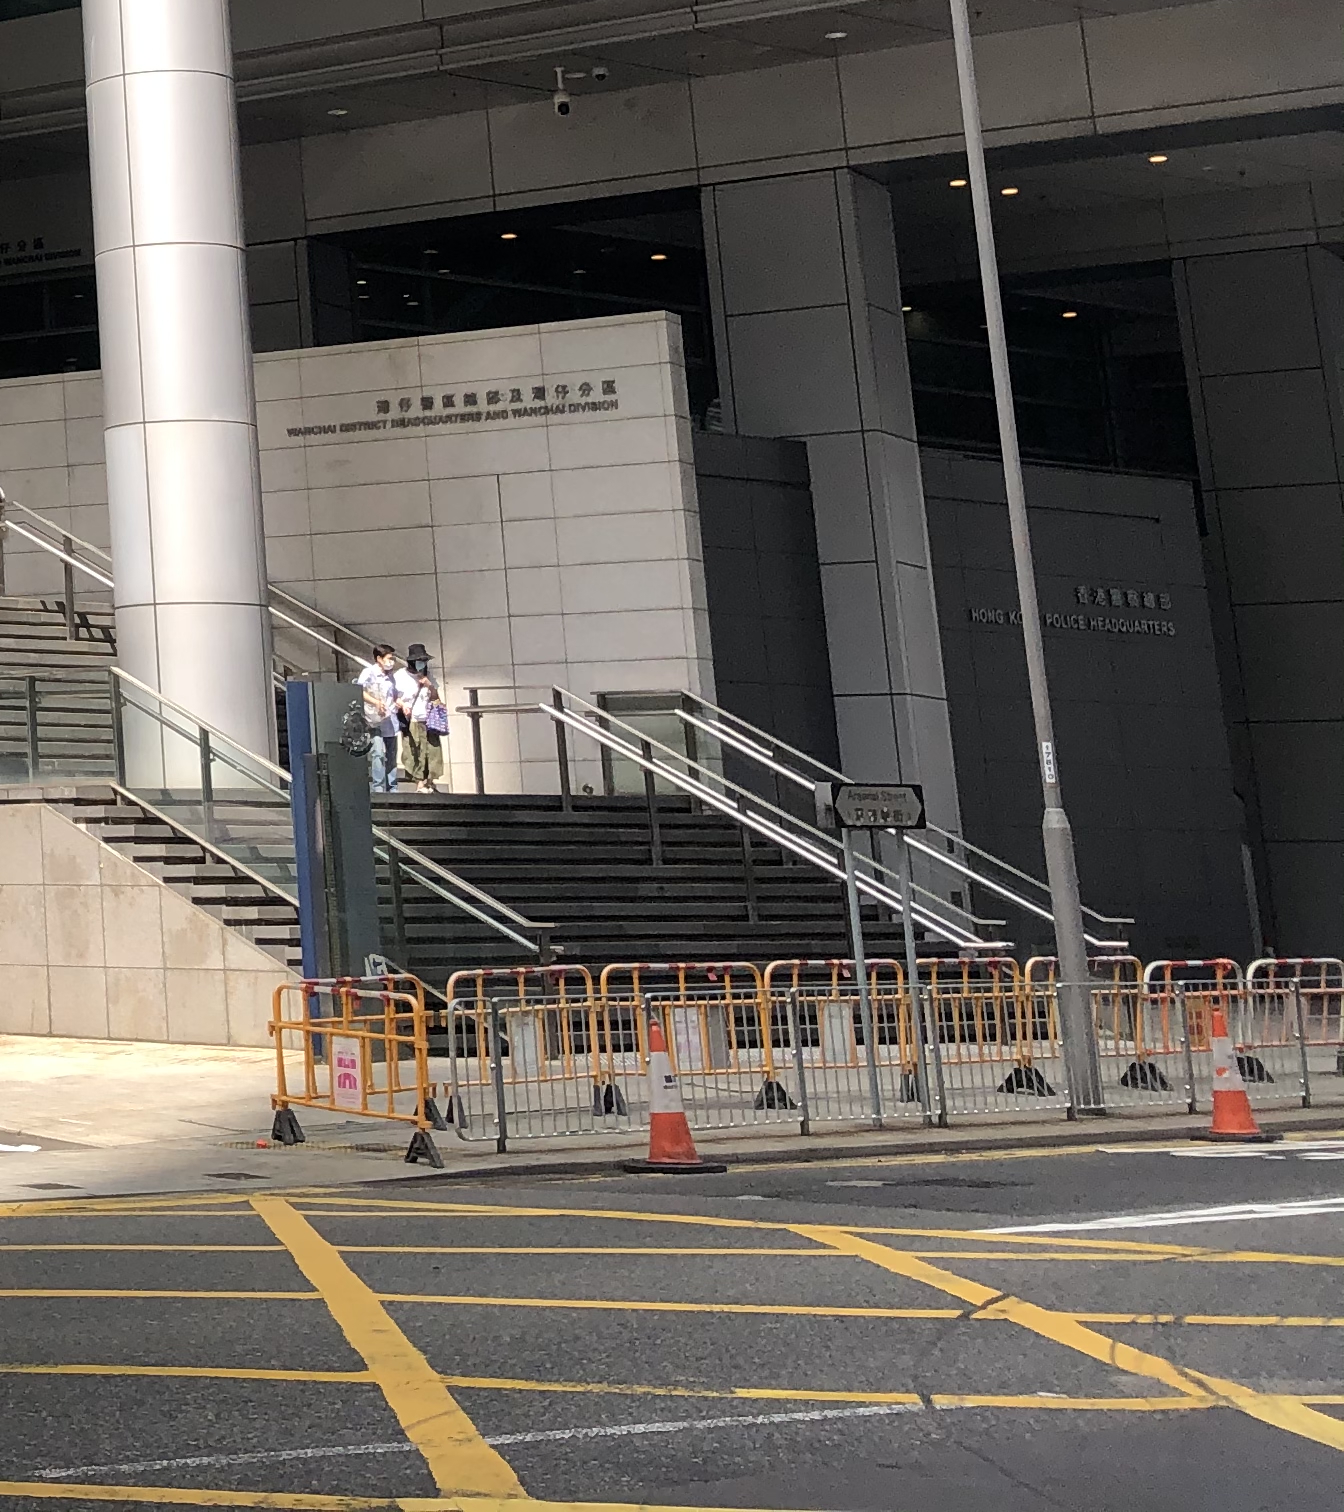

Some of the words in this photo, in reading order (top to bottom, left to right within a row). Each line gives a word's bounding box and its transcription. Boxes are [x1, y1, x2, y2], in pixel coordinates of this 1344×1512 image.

[339, 419, 388, 433] DISTRICT
[484, 408, 509, 421] AND
[511, 403, 567, 419] WANCHAI
[568, 399, 619, 414] DIVISION
[971, 608, 1004, 625] HONG
[1045, 613, 1086, 630] POLICE
[1089, 616, 1176, 636] HEADQUARTERS
